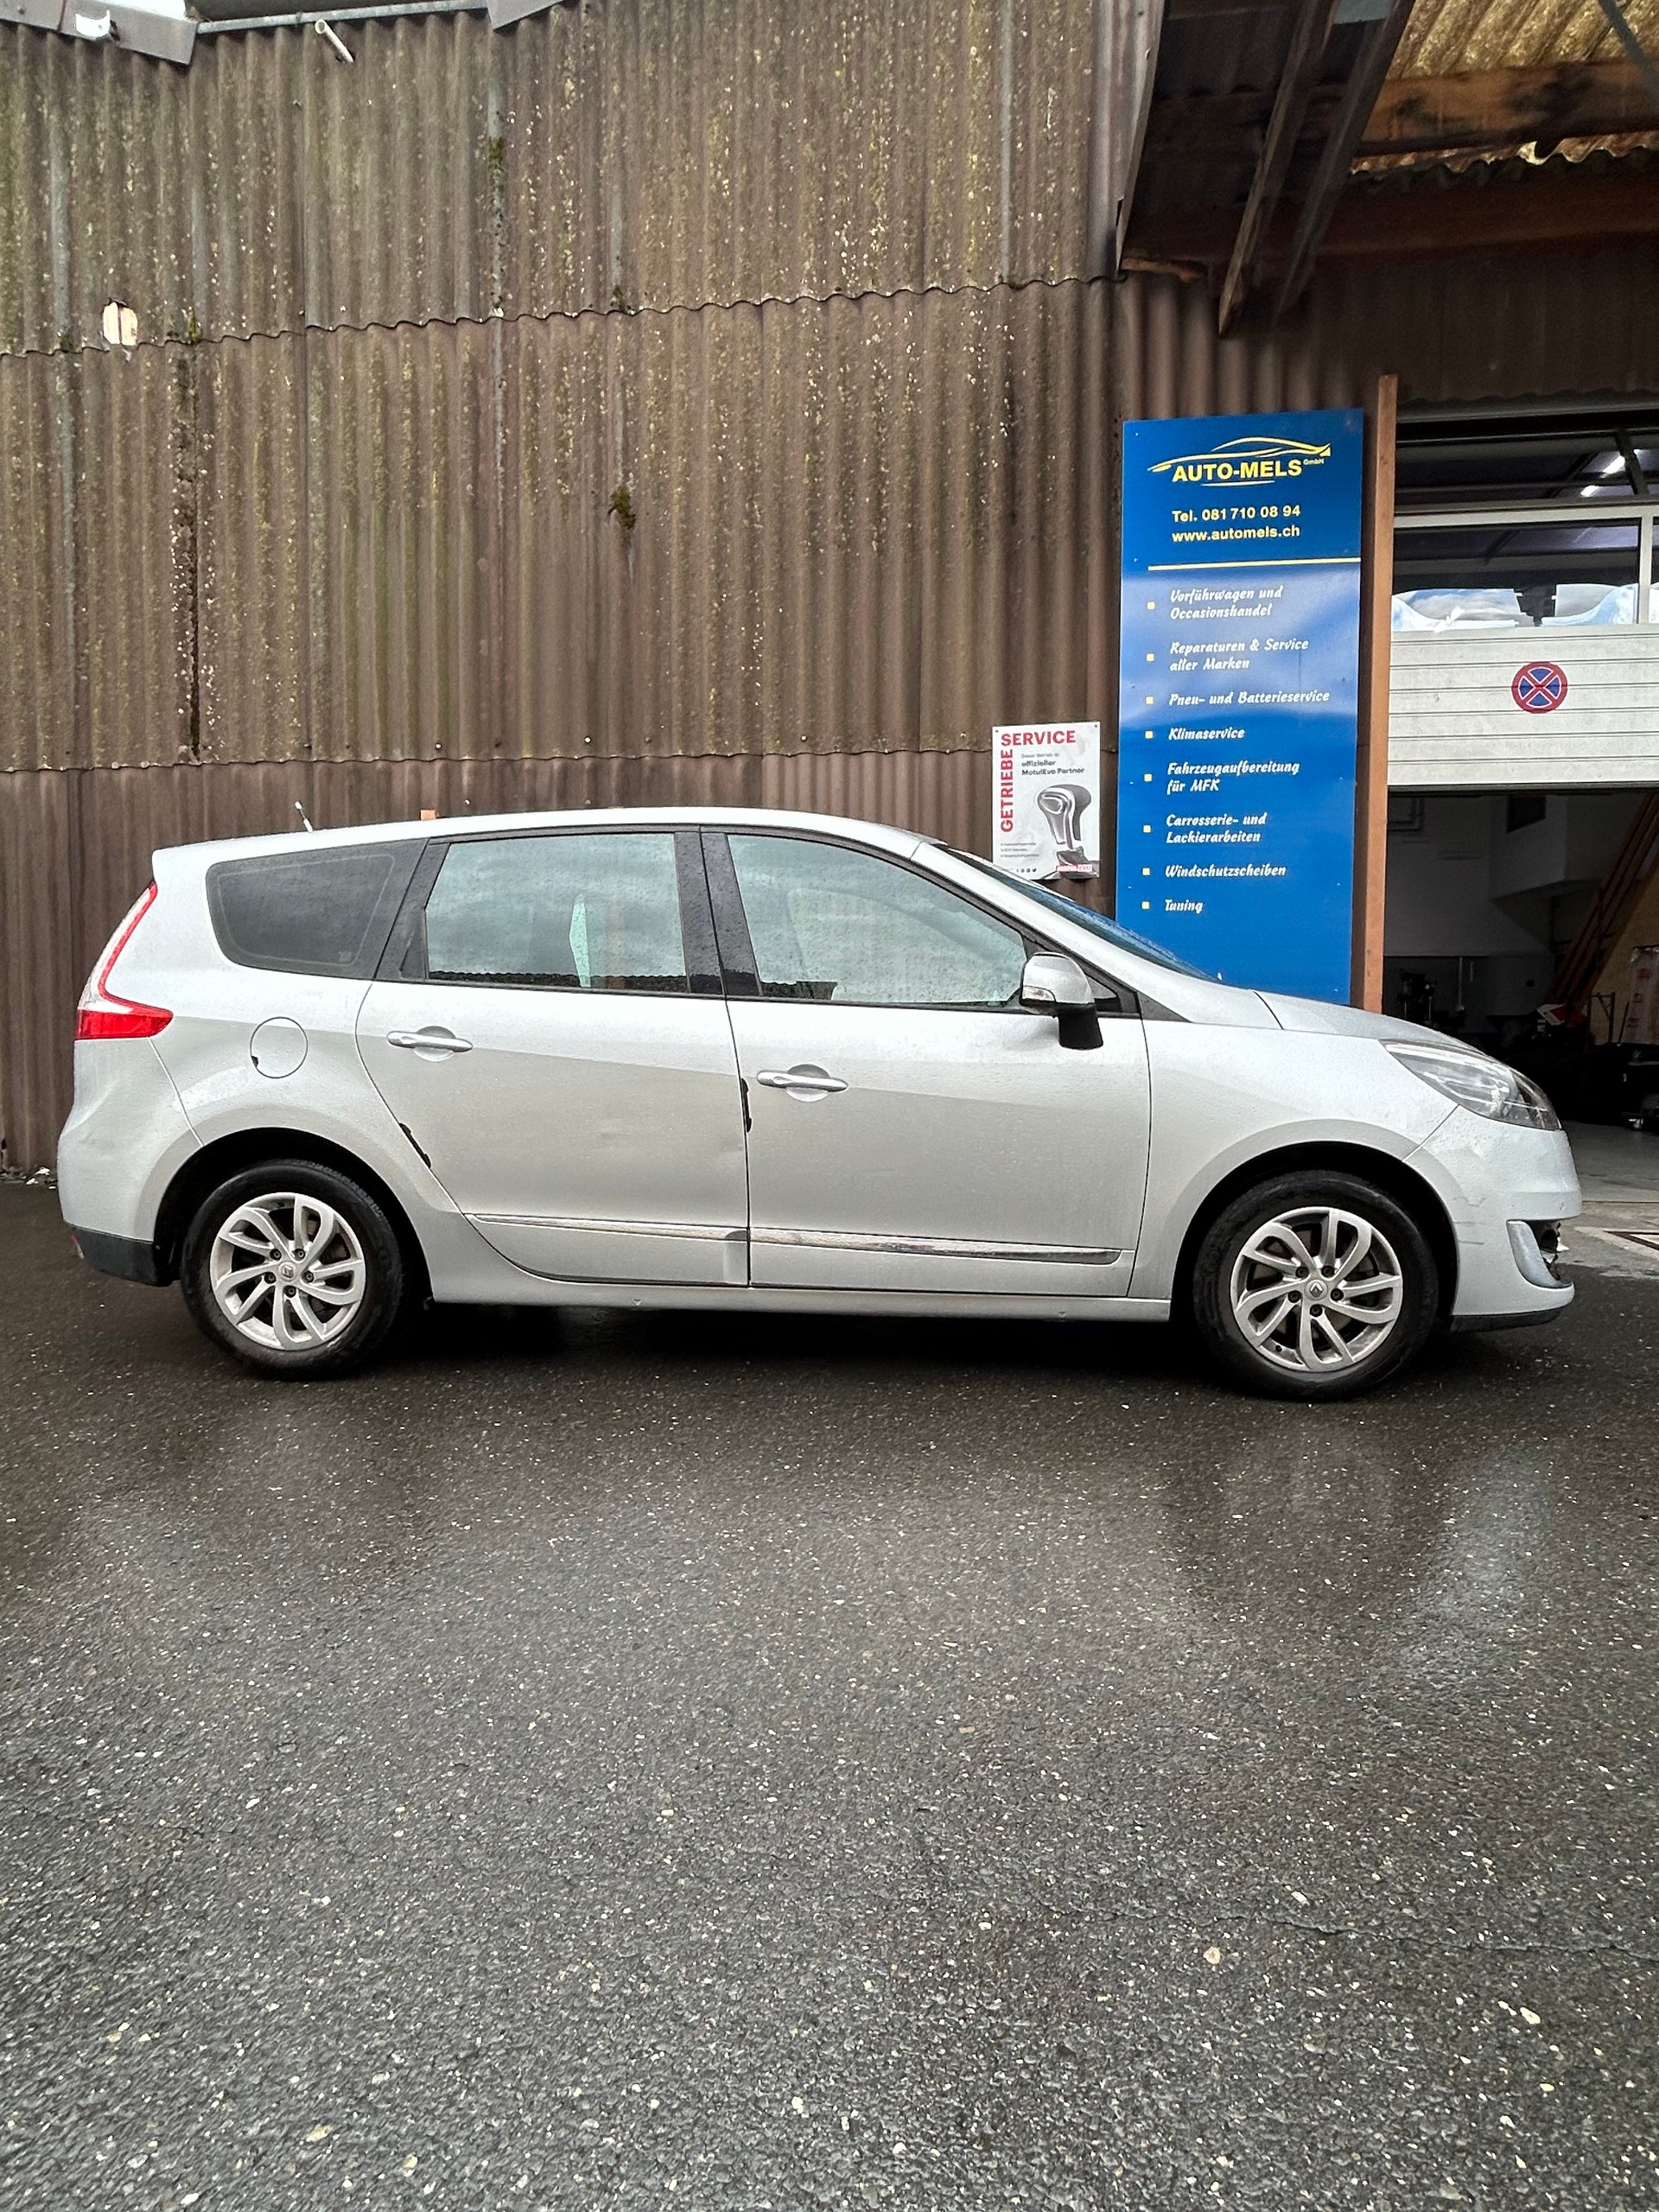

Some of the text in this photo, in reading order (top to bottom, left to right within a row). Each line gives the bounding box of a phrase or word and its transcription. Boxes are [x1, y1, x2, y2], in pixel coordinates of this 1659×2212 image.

[1172, 460, 1302, 482] AUTO-MELS
[1172, 505, 1300, 522] Tel. 081 710 08 94
[1172, 525, 1300, 543] www.automels.ch
[1170, 586, 1283, 604] Vorführwagen und
[1170, 604, 1273, 620] Occasionshandel
[1170, 638, 1309, 655] Reparaturen & Service
[1170, 658, 1250, 671] aller Marken
[1169, 690, 1330, 706] Pneu- und Batterieservice
[1001, 730, 1076, 747] SERVICE
[1168, 727, 1245, 741] Klimaservice
[1167, 760, 1300, 777] Fahrzeugaufbereitung
[1000, 749, 1014, 833] GETRIEBE
[1166, 779, 1220, 795] für MFK
[1166, 812, 1268, 827] Carrosserie- und
[1166, 830, 1261, 844] Lackierarbeiten
[1165, 864, 1287, 878] Windschutzscheiben
[1165, 899, 1204, 914] Tuning
